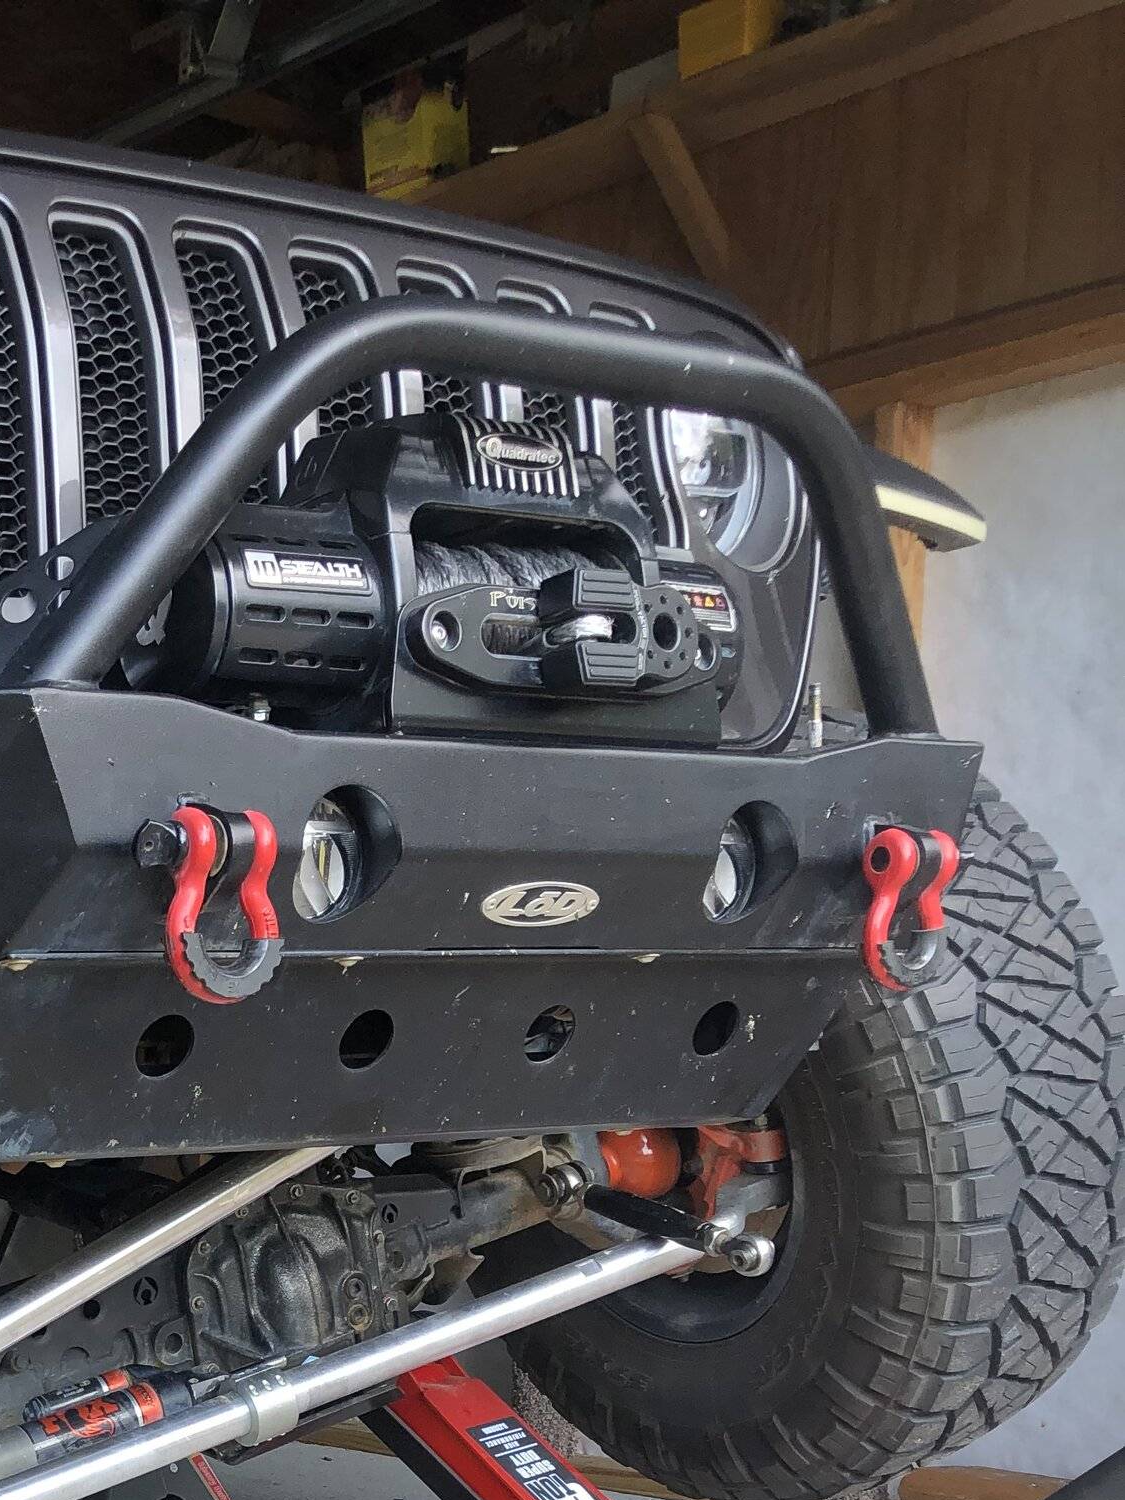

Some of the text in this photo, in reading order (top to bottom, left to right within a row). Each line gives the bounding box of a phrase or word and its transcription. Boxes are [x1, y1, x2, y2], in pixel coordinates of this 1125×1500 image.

[485, 436, 559, 464] Quadratec
[279, 559, 363, 579] STEALTH
[509, 1450, 541, 1467] DUTY
[515, 1459, 556, 1479] SUPER
